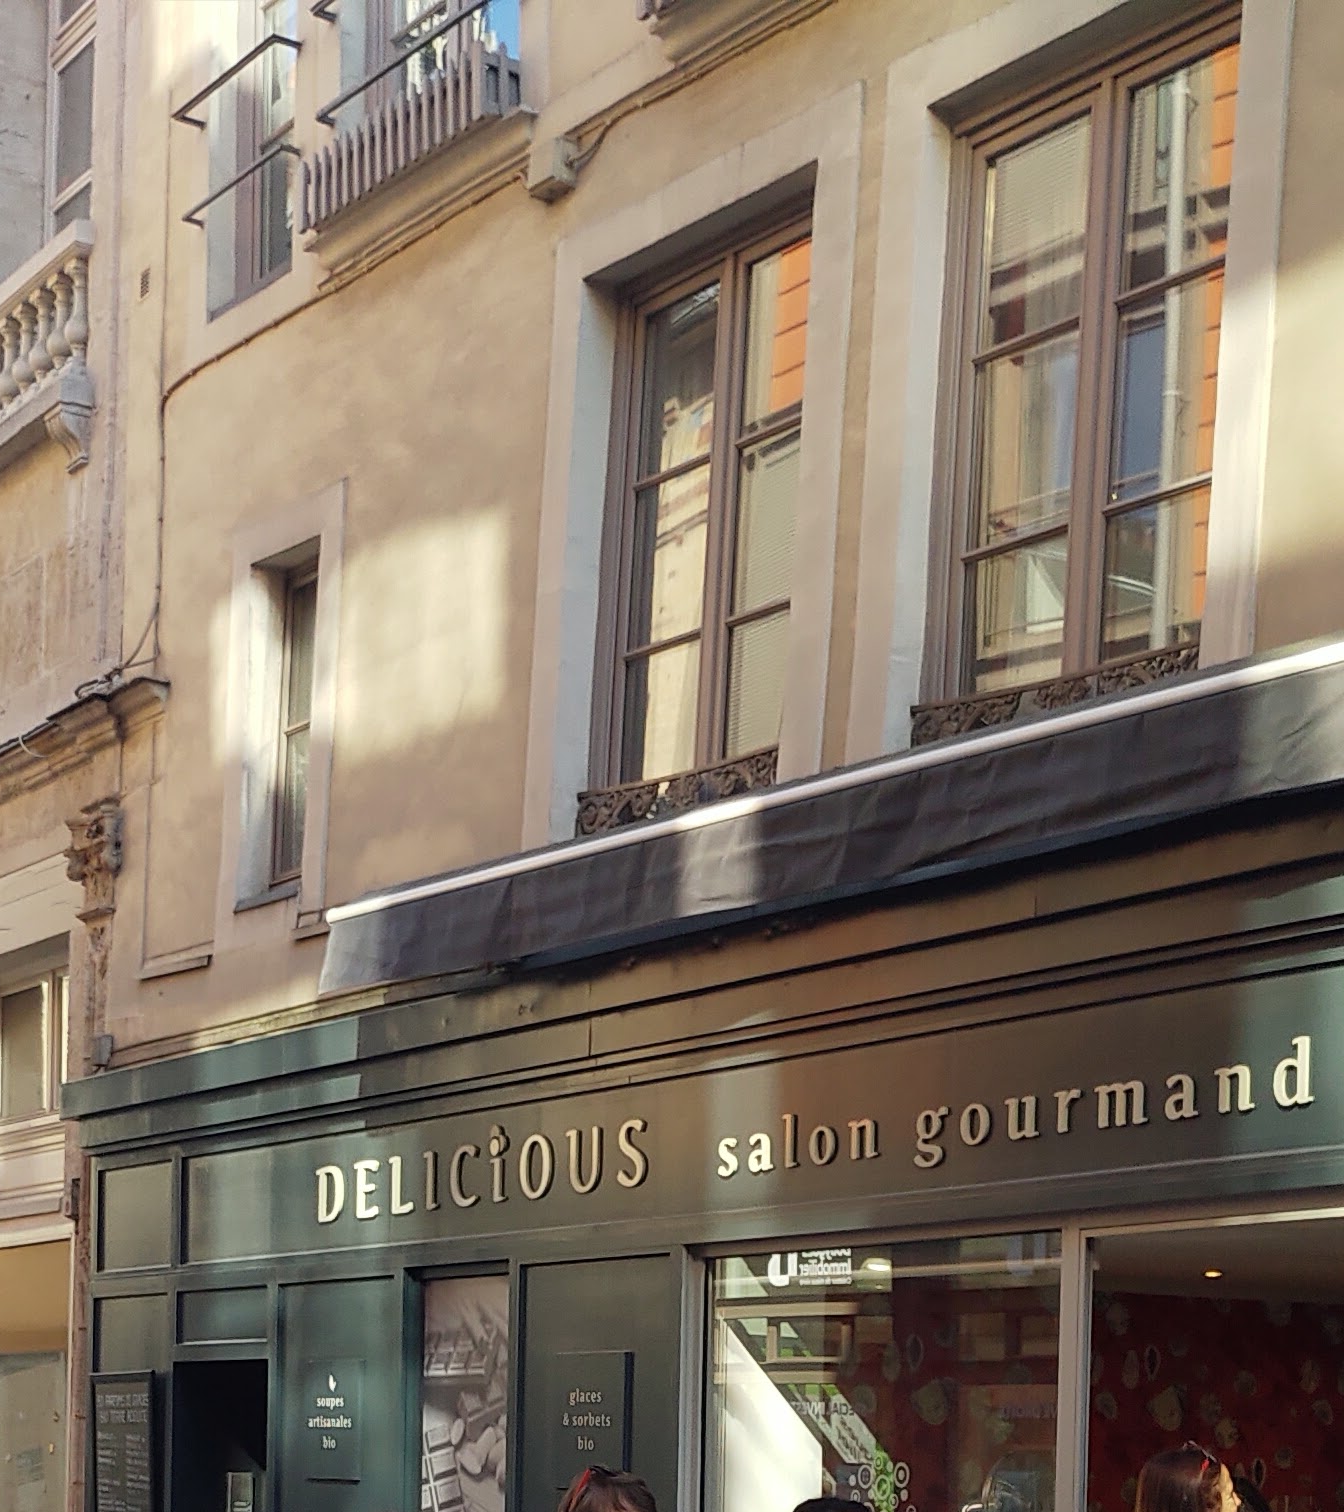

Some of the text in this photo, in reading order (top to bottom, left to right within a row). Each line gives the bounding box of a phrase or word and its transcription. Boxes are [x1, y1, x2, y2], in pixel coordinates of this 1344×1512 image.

[717, 1113, 879, 1178] salon
[913, 1035, 1315, 1168] gourmand
[316, 1397, 344, 1410] soupes
[568, 1387, 602, 1407] glaces
[308, 1415, 352, 1429] artisanales
[562, 1411, 611, 1427] & sorbets
[322, 1435, 337, 1449] bio
[577, 1435, 595, 1451] bio
